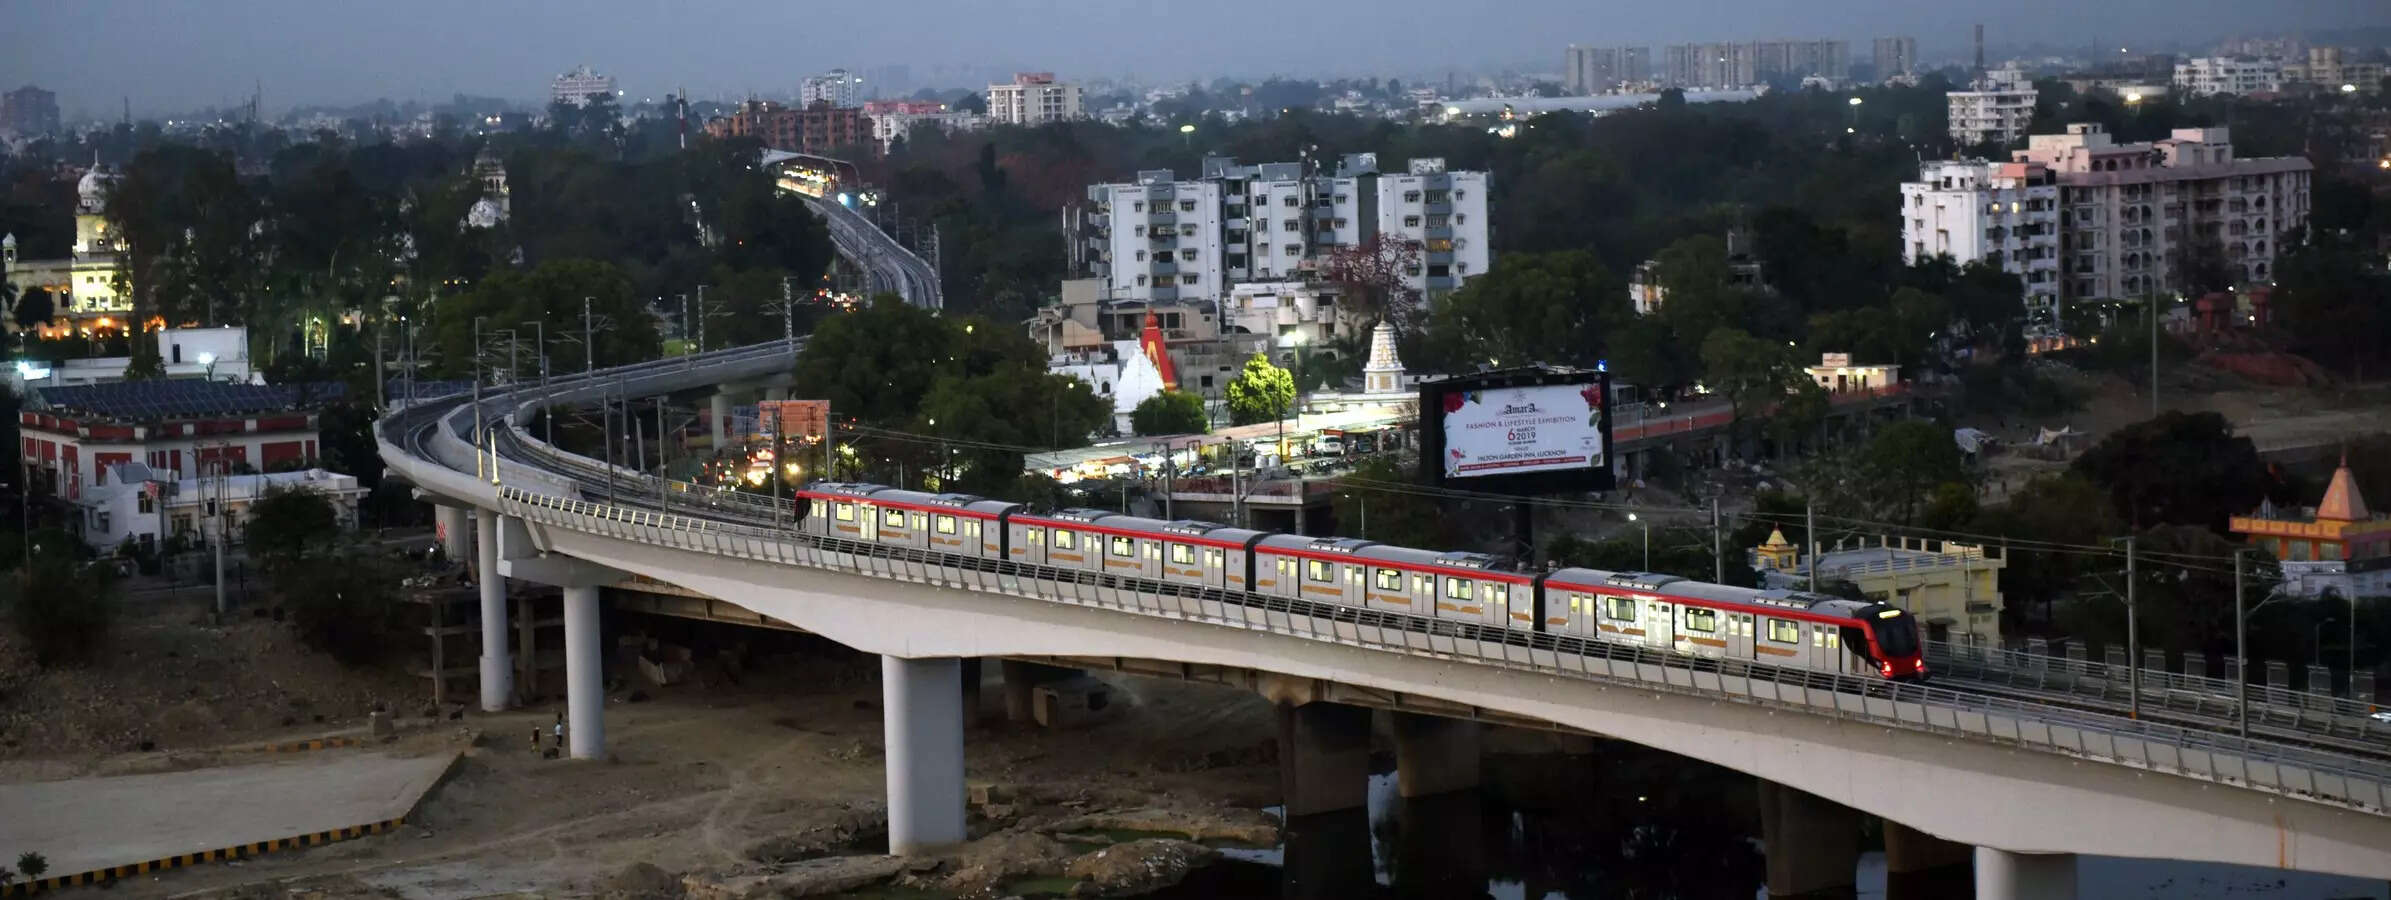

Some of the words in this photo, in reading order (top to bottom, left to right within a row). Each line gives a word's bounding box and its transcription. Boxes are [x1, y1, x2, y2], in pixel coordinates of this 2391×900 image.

[1466, 422, 1496, 430] FASHION
[1504, 419, 1536, 427] LIFESTYLE
[1538, 415, 1576, 425] EXHIBITION
[1508, 428, 1516, 441] 6
[1516, 431, 1536, 440] 2019
